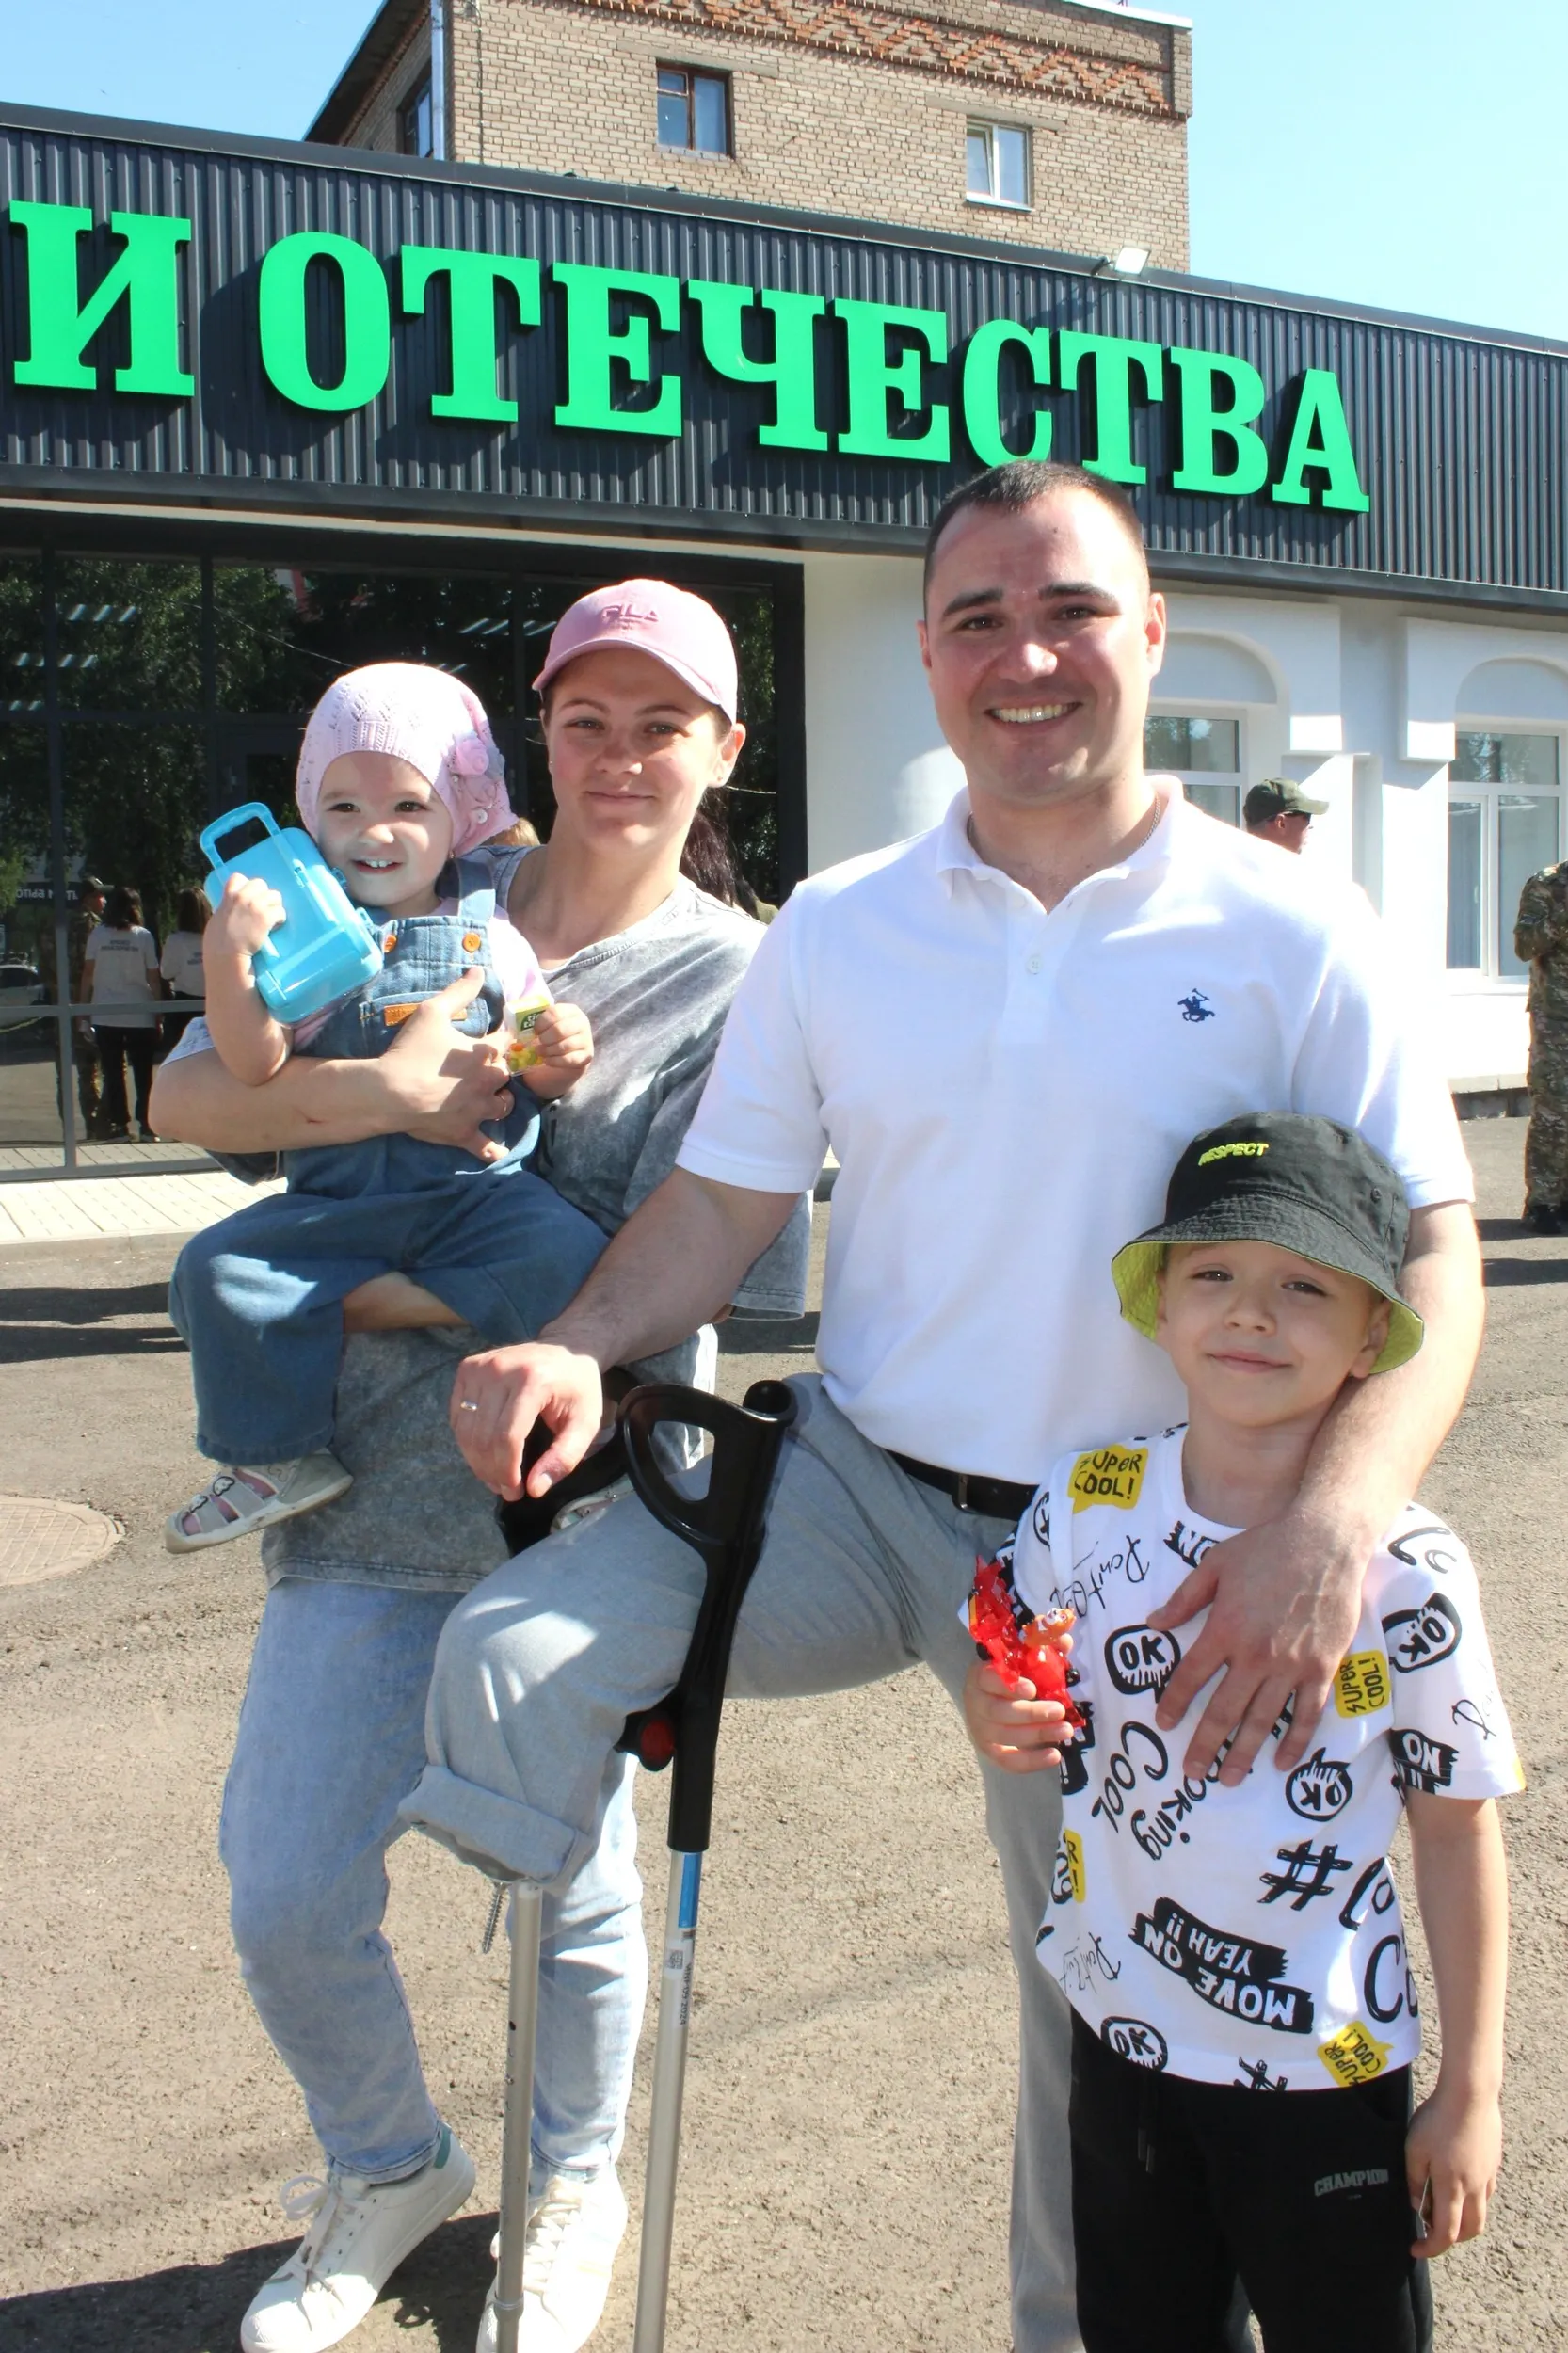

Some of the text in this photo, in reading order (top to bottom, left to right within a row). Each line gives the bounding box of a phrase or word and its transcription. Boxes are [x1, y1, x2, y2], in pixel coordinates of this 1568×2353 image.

[9, 200, 1370, 512] И ОТЕЧЕСТВА
[1119, 1635, 1166, 1670] OK
[1399, 1616, 1447, 1662] OK
[1301, 1782, 1344, 1811] OK
[1188, 1928, 1253, 1976] YEAH
[1144, 1923, 1296, 2026] MOVE ON
[1114, 2027, 1156, 2057] OK
[1314, 2169, 1388, 2197] CHAMPION
